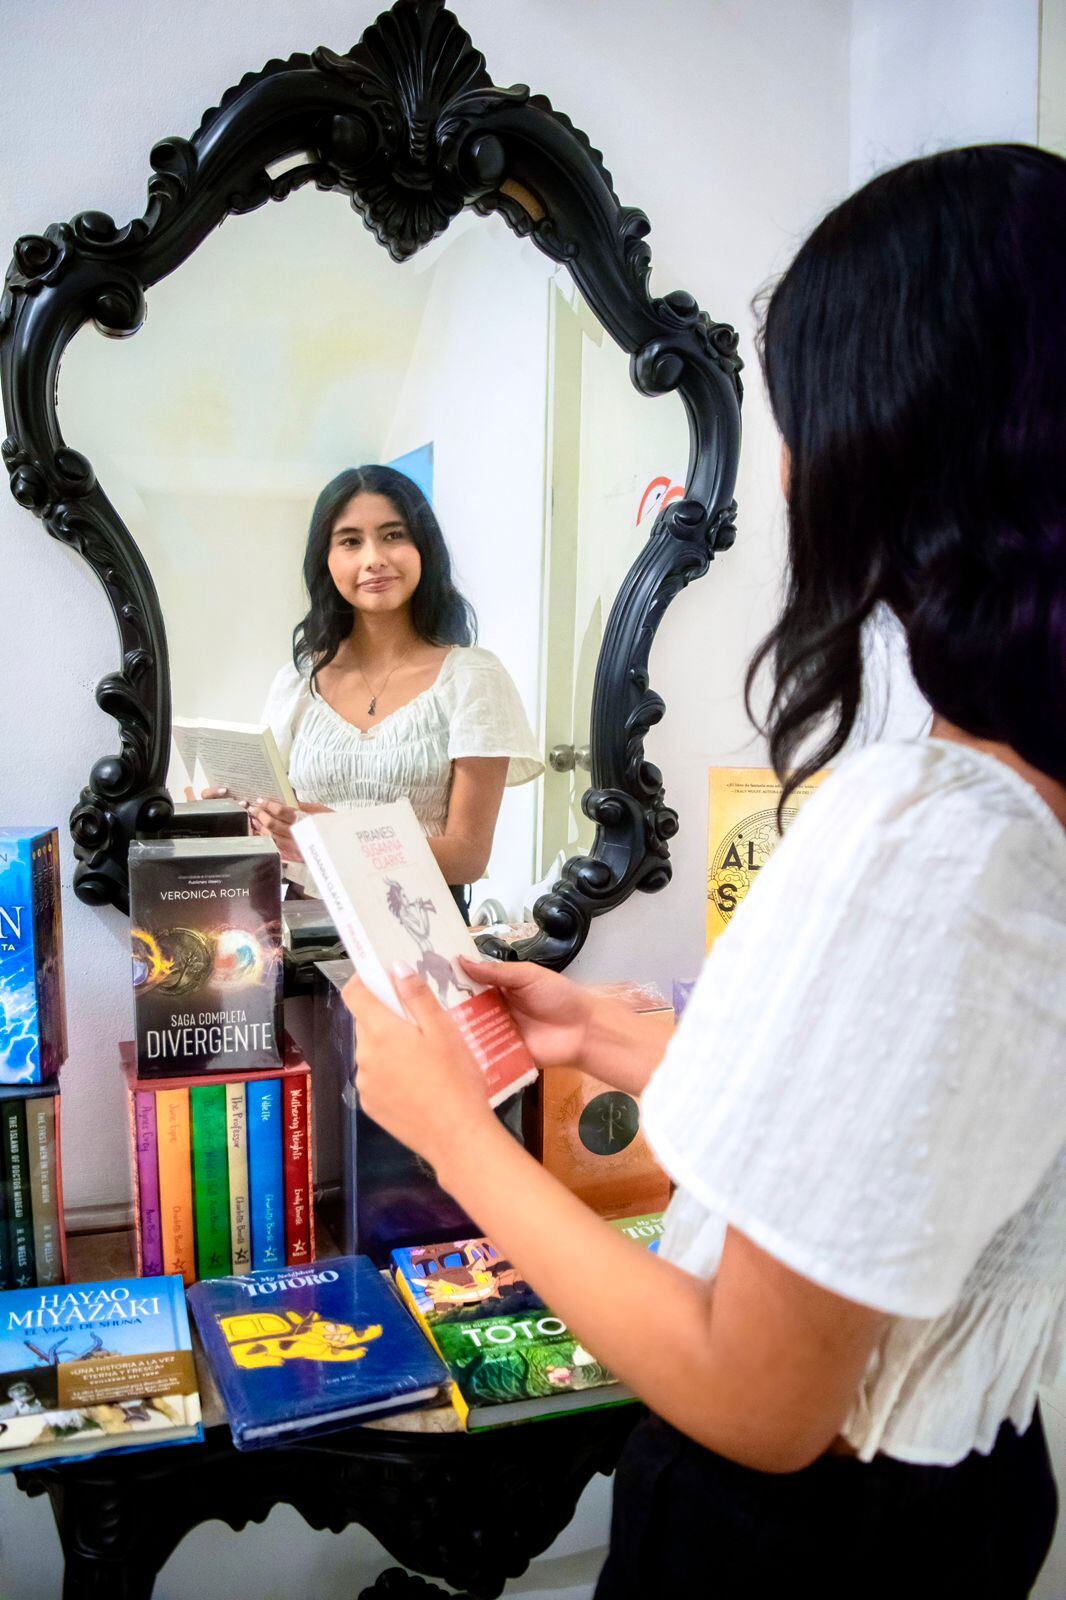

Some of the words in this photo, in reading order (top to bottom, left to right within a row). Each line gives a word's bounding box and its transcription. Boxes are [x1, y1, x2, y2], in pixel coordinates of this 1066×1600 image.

[160, 889, 217, 901] VERONICA
[220, 887, 250, 898] ROTH
[171, 1013, 196, 1028] SAGA
[198, 1010, 247, 1026] COMPLETA
[147, 1022, 272, 1059] DIVERGENTE
[231, 1096, 243, 1111] The
[289, 1089, 302, 1129] Wuthering
[8, 1115, 18, 1129] THE
[229, 1112, 243, 1148] Professor
[10, 1130, 19, 1153] ISLAND
[289, 1131, 303, 1161] Heights
[12, 1154, 20, 1163] OF
[12, 1164, 21, 1190] DOCTOR
[14, 1191, 23, 1218] MOREAU
[18, 1245, 27, 1267] WELLS
[242, 1270, 339, 1297] TOTORO
[40, 1287, 130, 1309] HAYAO
[7, 1297, 161, 1330] MIYAZAKI
[42, 1325, 76, 1335] VIAJE
[79, 1322, 95, 1330] DE
[99, 1318, 143, 1329] SHUNA
[83, 1371, 119, 1380] ETERNA
[96, 1362, 137, 1373] HISTORIA
